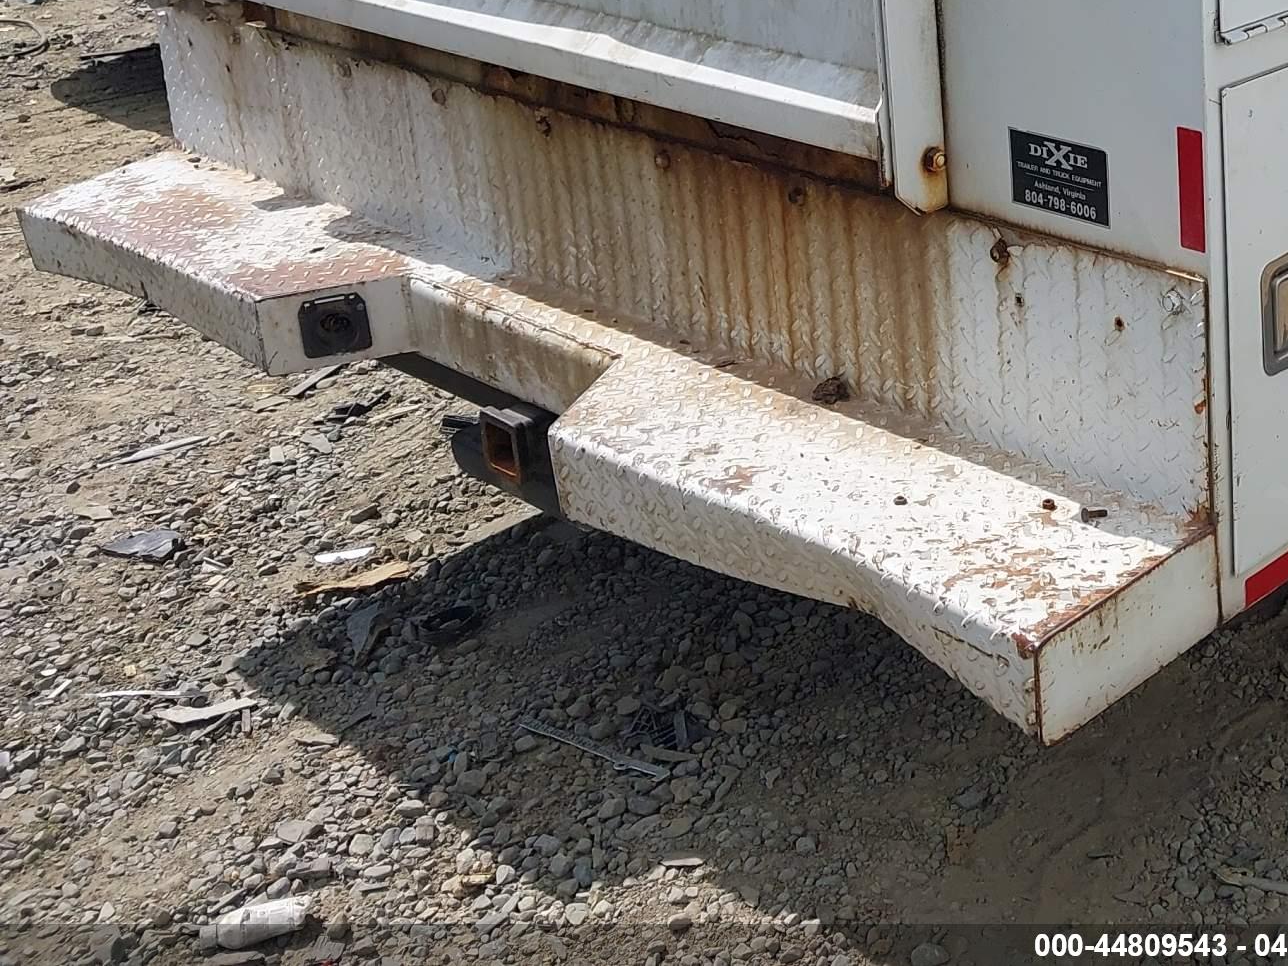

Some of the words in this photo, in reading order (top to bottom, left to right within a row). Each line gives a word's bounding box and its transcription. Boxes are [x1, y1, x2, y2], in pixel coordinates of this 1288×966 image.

[1028, 141, 1088, 170] DIXIE
[1039, 166, 1051, 175] AND
[1052, 169, 1070, 180] TRUCK
[1025, 189, 1097, 220] 804-798-6006
